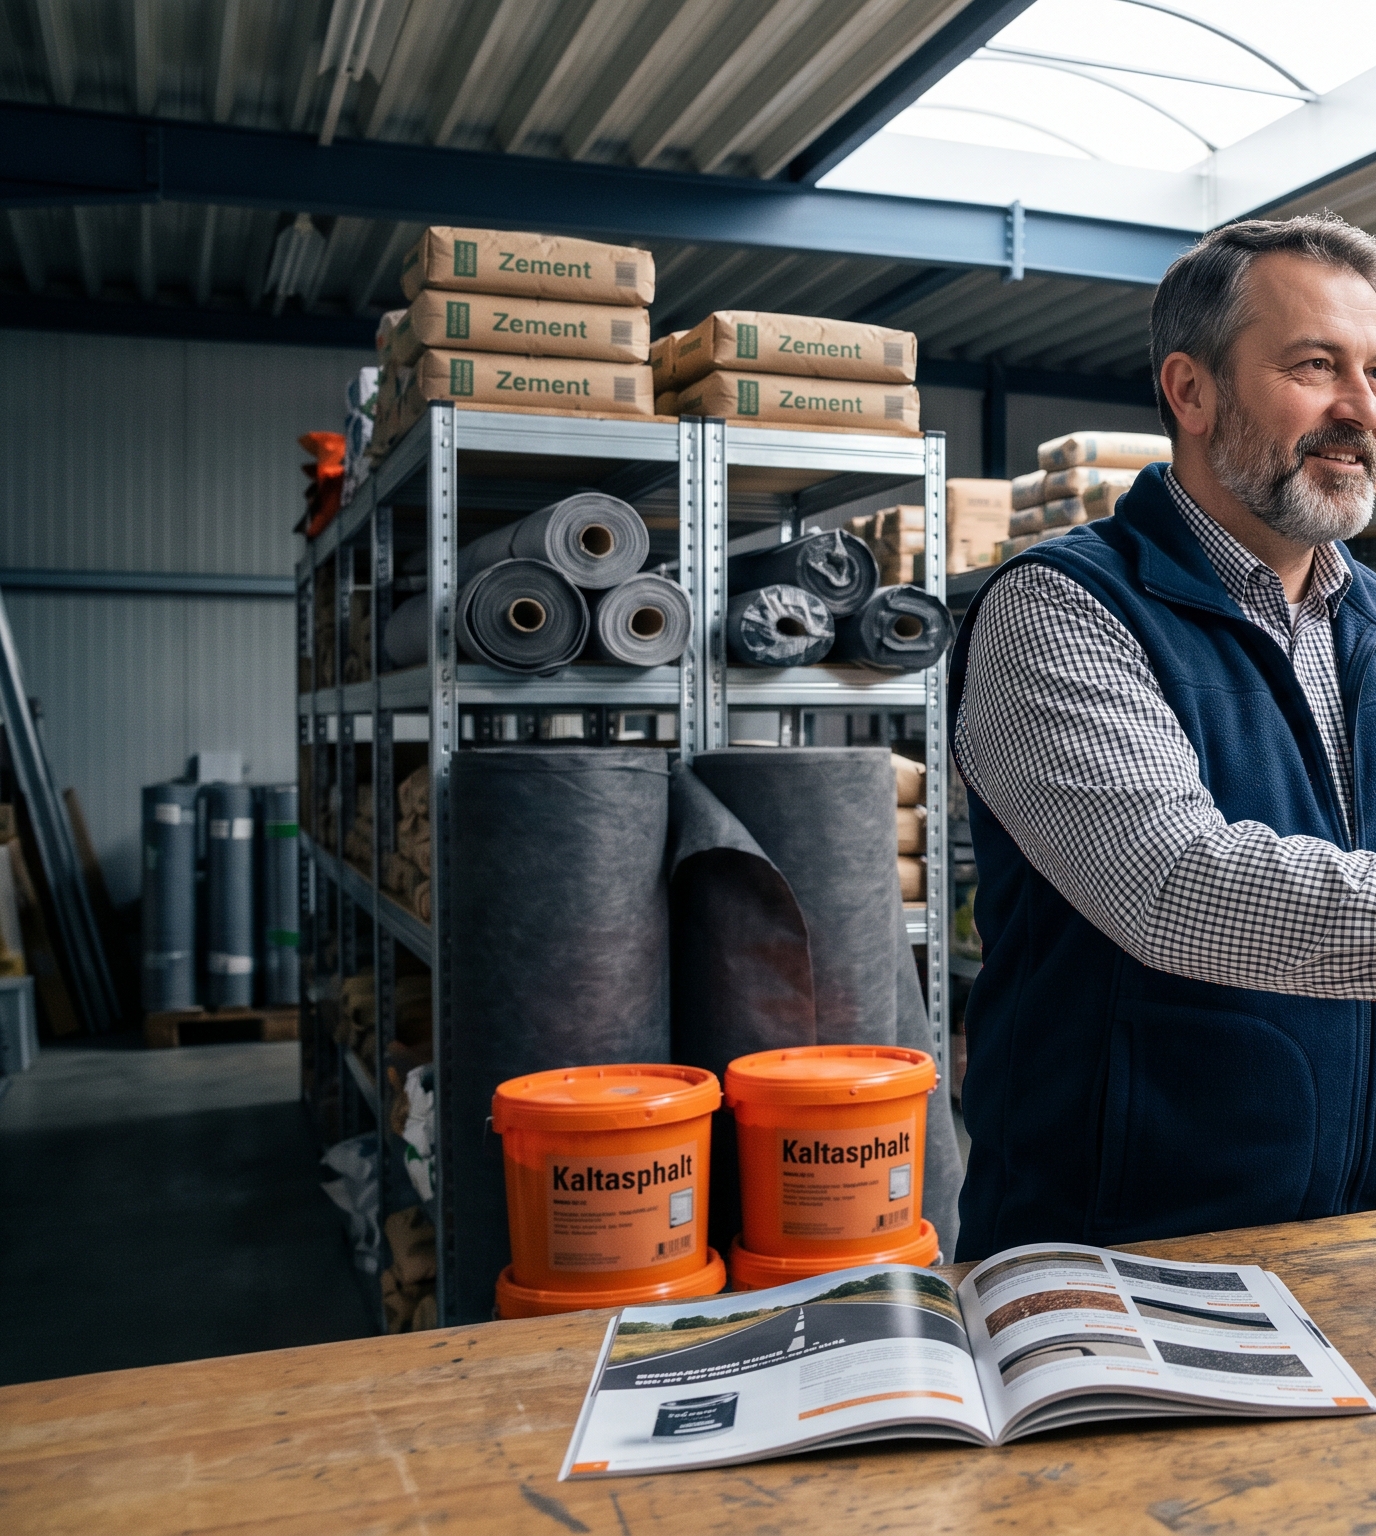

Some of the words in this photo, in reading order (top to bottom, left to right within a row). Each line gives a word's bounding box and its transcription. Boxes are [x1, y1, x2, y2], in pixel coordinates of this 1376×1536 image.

[498, 252, 592, 280] Zement
[492, 312, 588, 339] Zement
[778, 335, 862, 360] Zement
[496, 370, 590, 396] Zement
[779, 390, 863, 414] Zement
[783, 1131, 910, 1169] Kaltasphalt
[553, 1154, 692, 1195] Kaltasphalt
